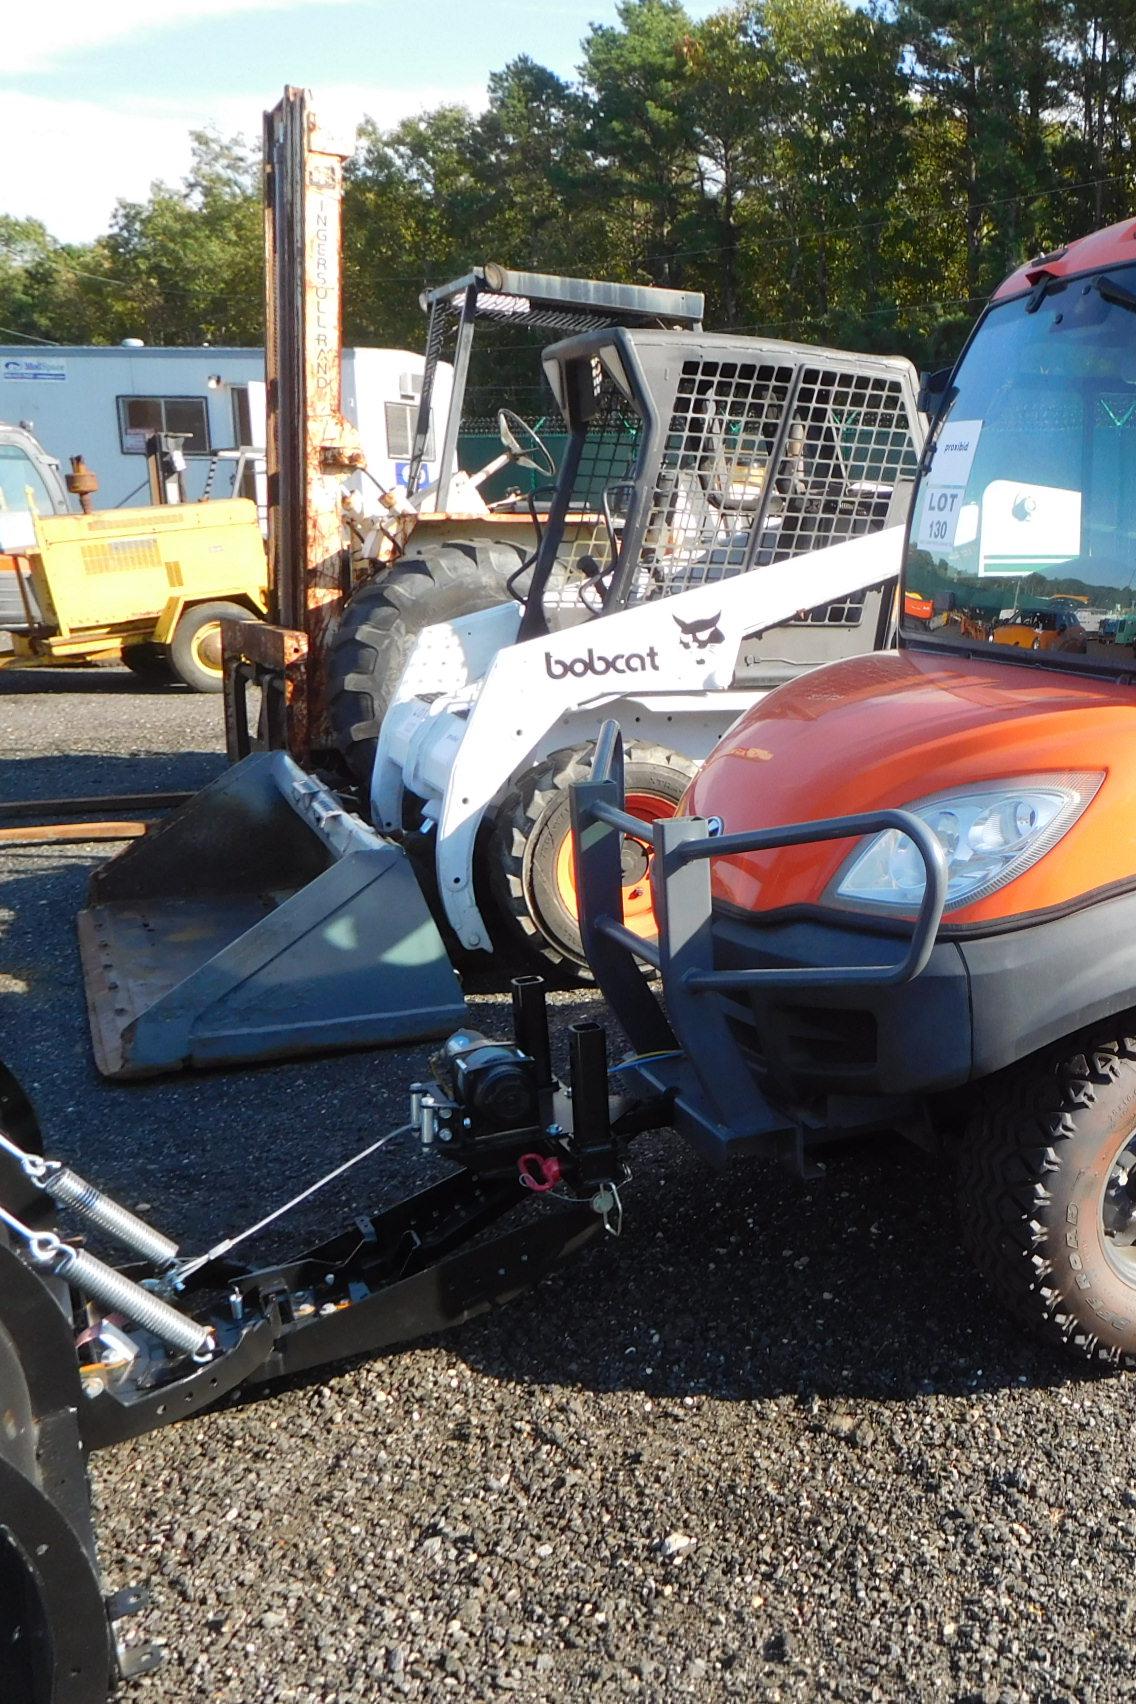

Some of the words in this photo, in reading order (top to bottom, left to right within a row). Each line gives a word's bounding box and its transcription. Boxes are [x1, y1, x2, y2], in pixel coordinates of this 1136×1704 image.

[944, 442, 969, 453] proxibid
[928, 492, 958, 512] LOT
[928, 521, 948, 540] 130
[544, 646, 660, 680] bobcat
